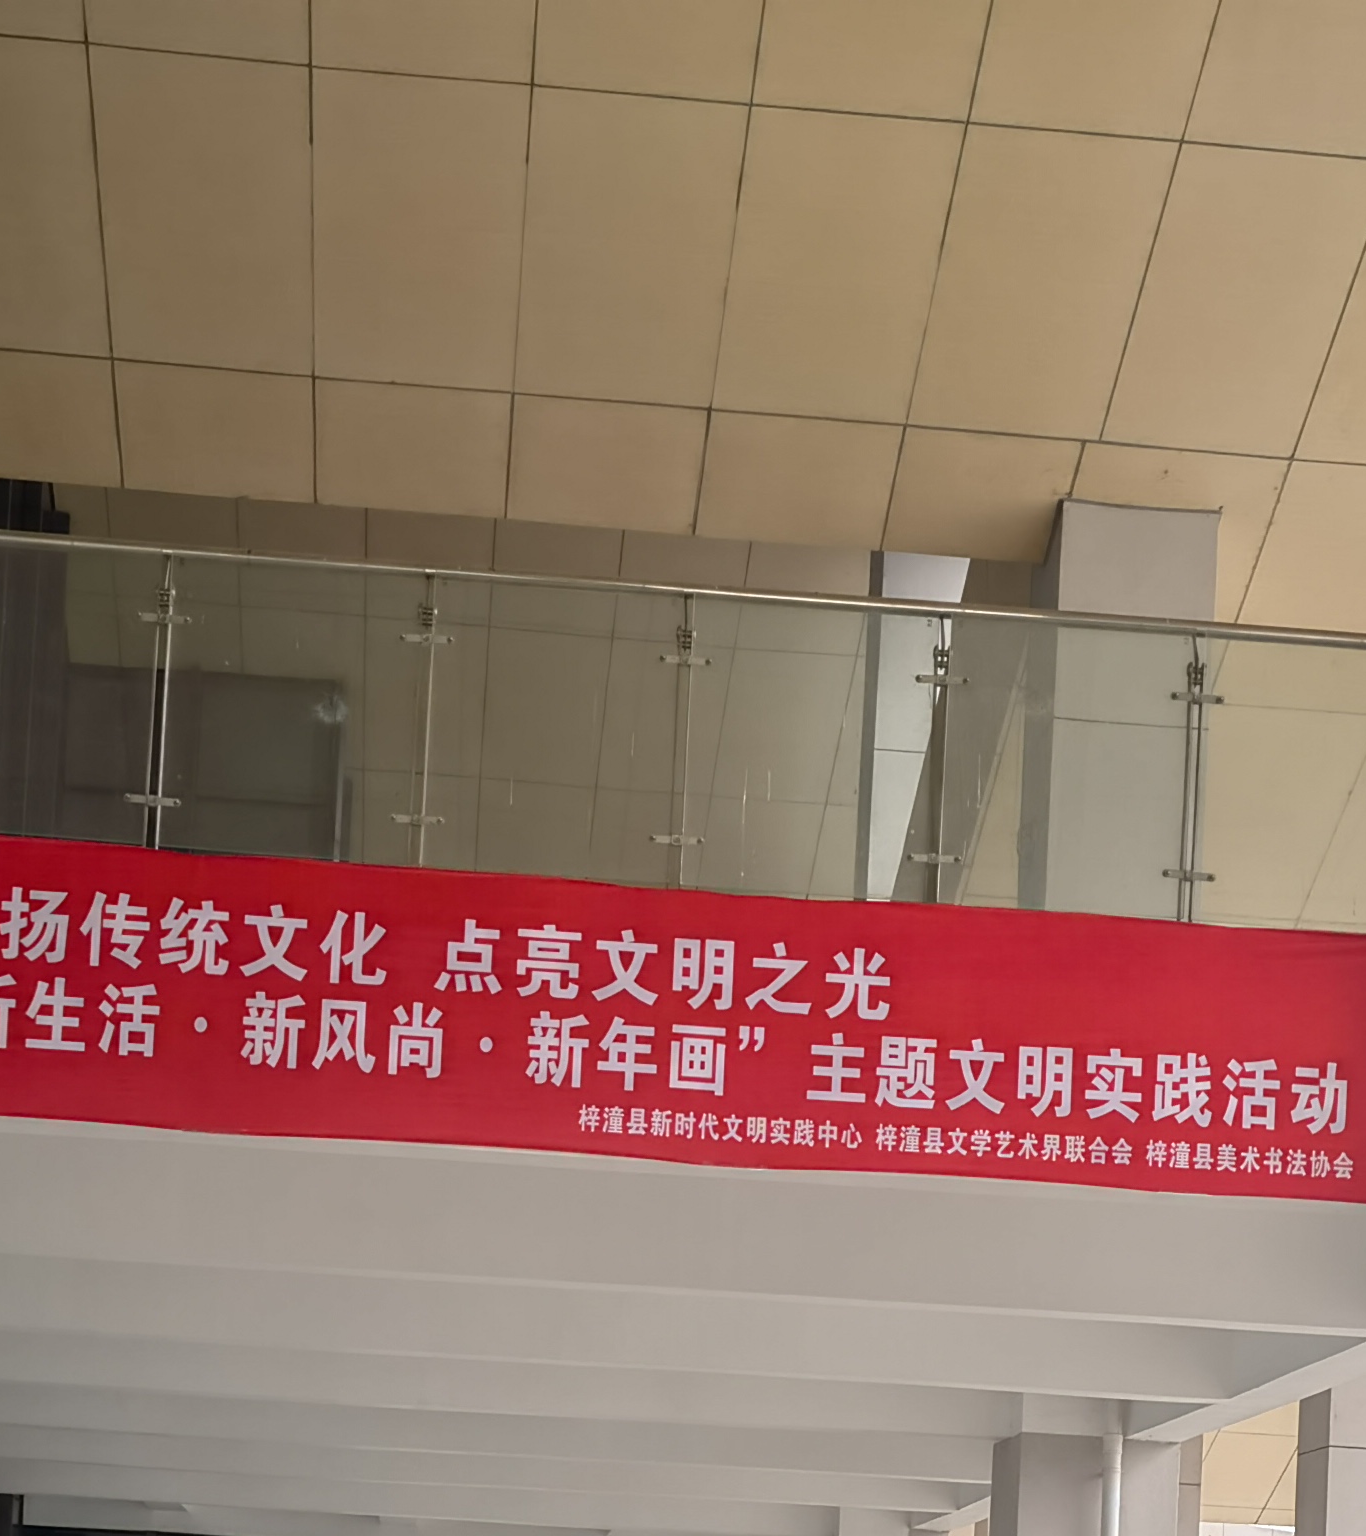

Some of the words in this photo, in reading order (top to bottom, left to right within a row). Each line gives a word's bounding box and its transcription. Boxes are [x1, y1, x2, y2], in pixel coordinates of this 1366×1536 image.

[434, 919, 891, 1021] 点亮文明之光
[807, 1033, 1347, 1134] 主题文明实践活动
[579, 1104, 863, 1149] 梓潼县新时代文明实践中心
[876, 1124, 1133, 1166] 梓潼县文学艺术界联合会
[1146, 1140, 1354, 1180] 梓潼县美术书法协会
